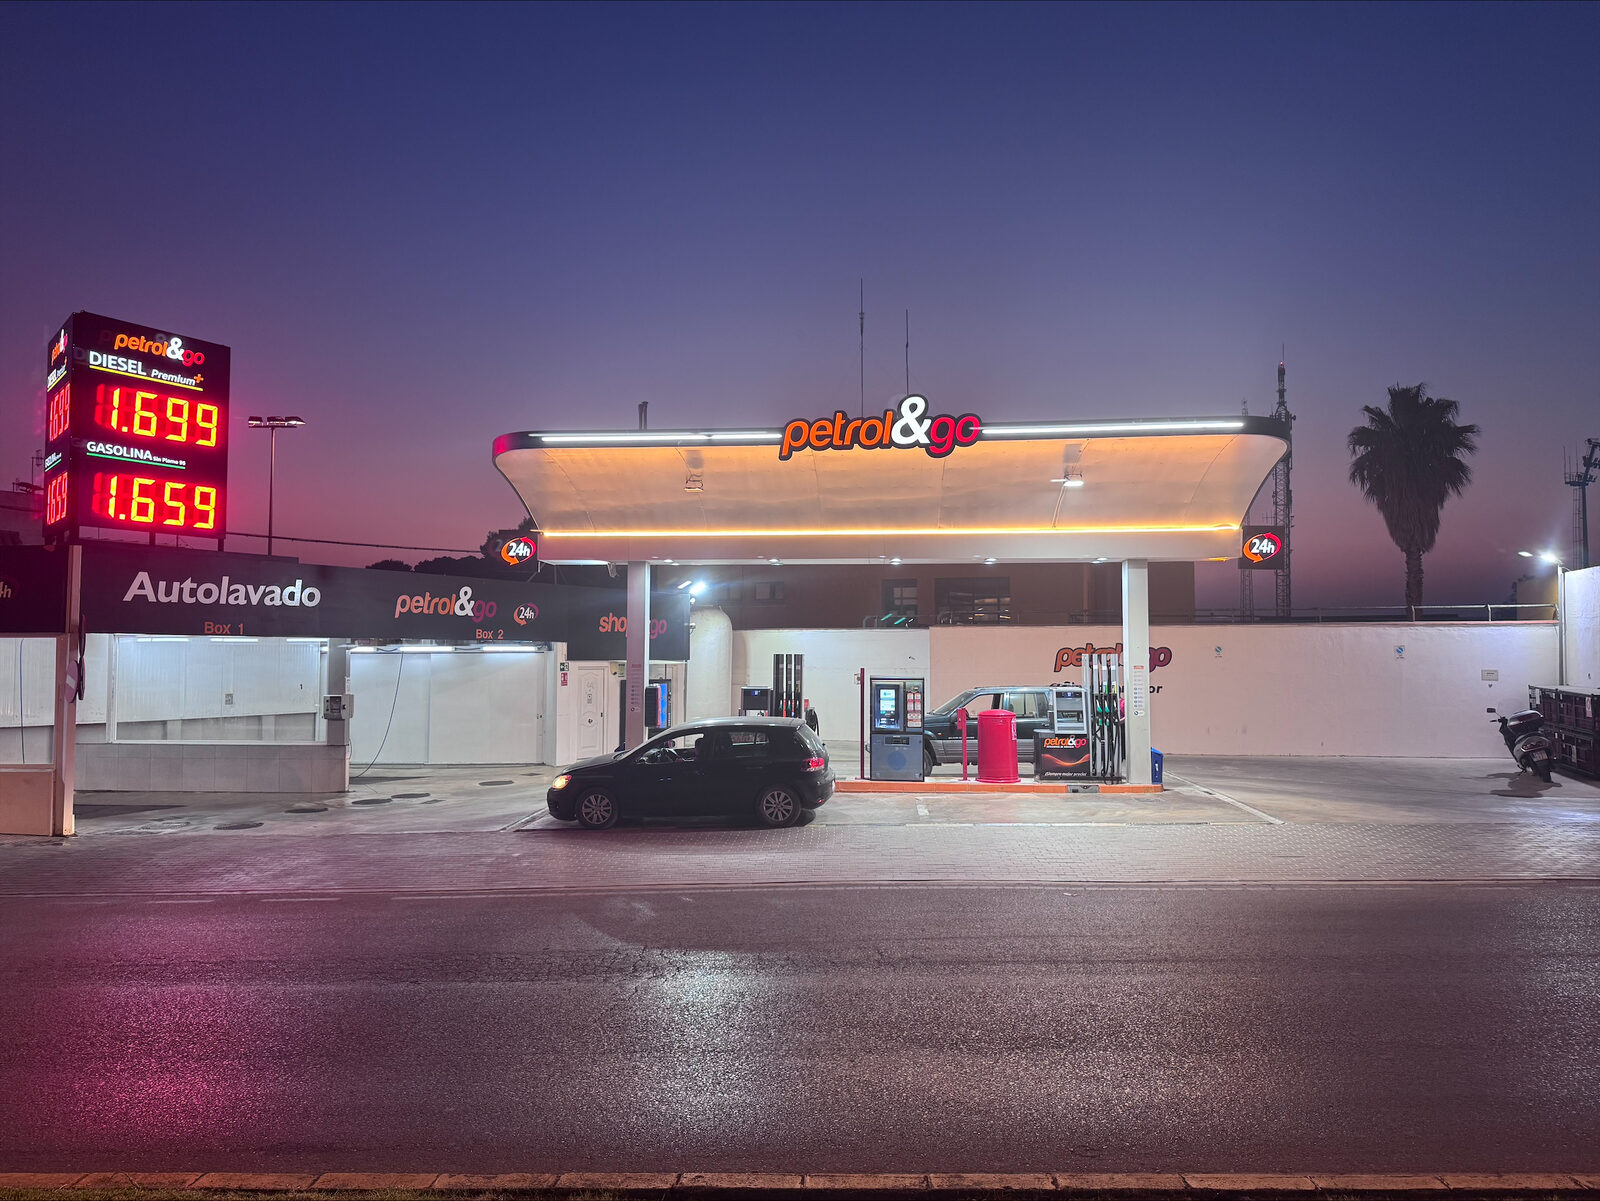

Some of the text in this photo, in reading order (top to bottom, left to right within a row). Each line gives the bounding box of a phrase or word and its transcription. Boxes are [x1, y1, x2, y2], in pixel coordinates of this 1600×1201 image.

[114, 333, 205, 367] petrol&go
[89, 350, 147, 376] DIESEL
[111, 387, 219, 447] 1.699
[780, 394, 982, 458] petrol&go
[86, 441, 153, 461] GASOLINA
[108, 475, 217, 530] 1.659
[508, 541, 531, 557] 24h
[1250, 538, 1275, 554] 24h
[123, 571, 321, 607] Autolavado
[395, 586, 497, 623] petrol&go
[519, 606, 535, 619] 24h
[204, 622, 244, 635] Box 1
[475, 629, 504, 639] Box 2
[1044, 735, 1087, 749] petrol&go
